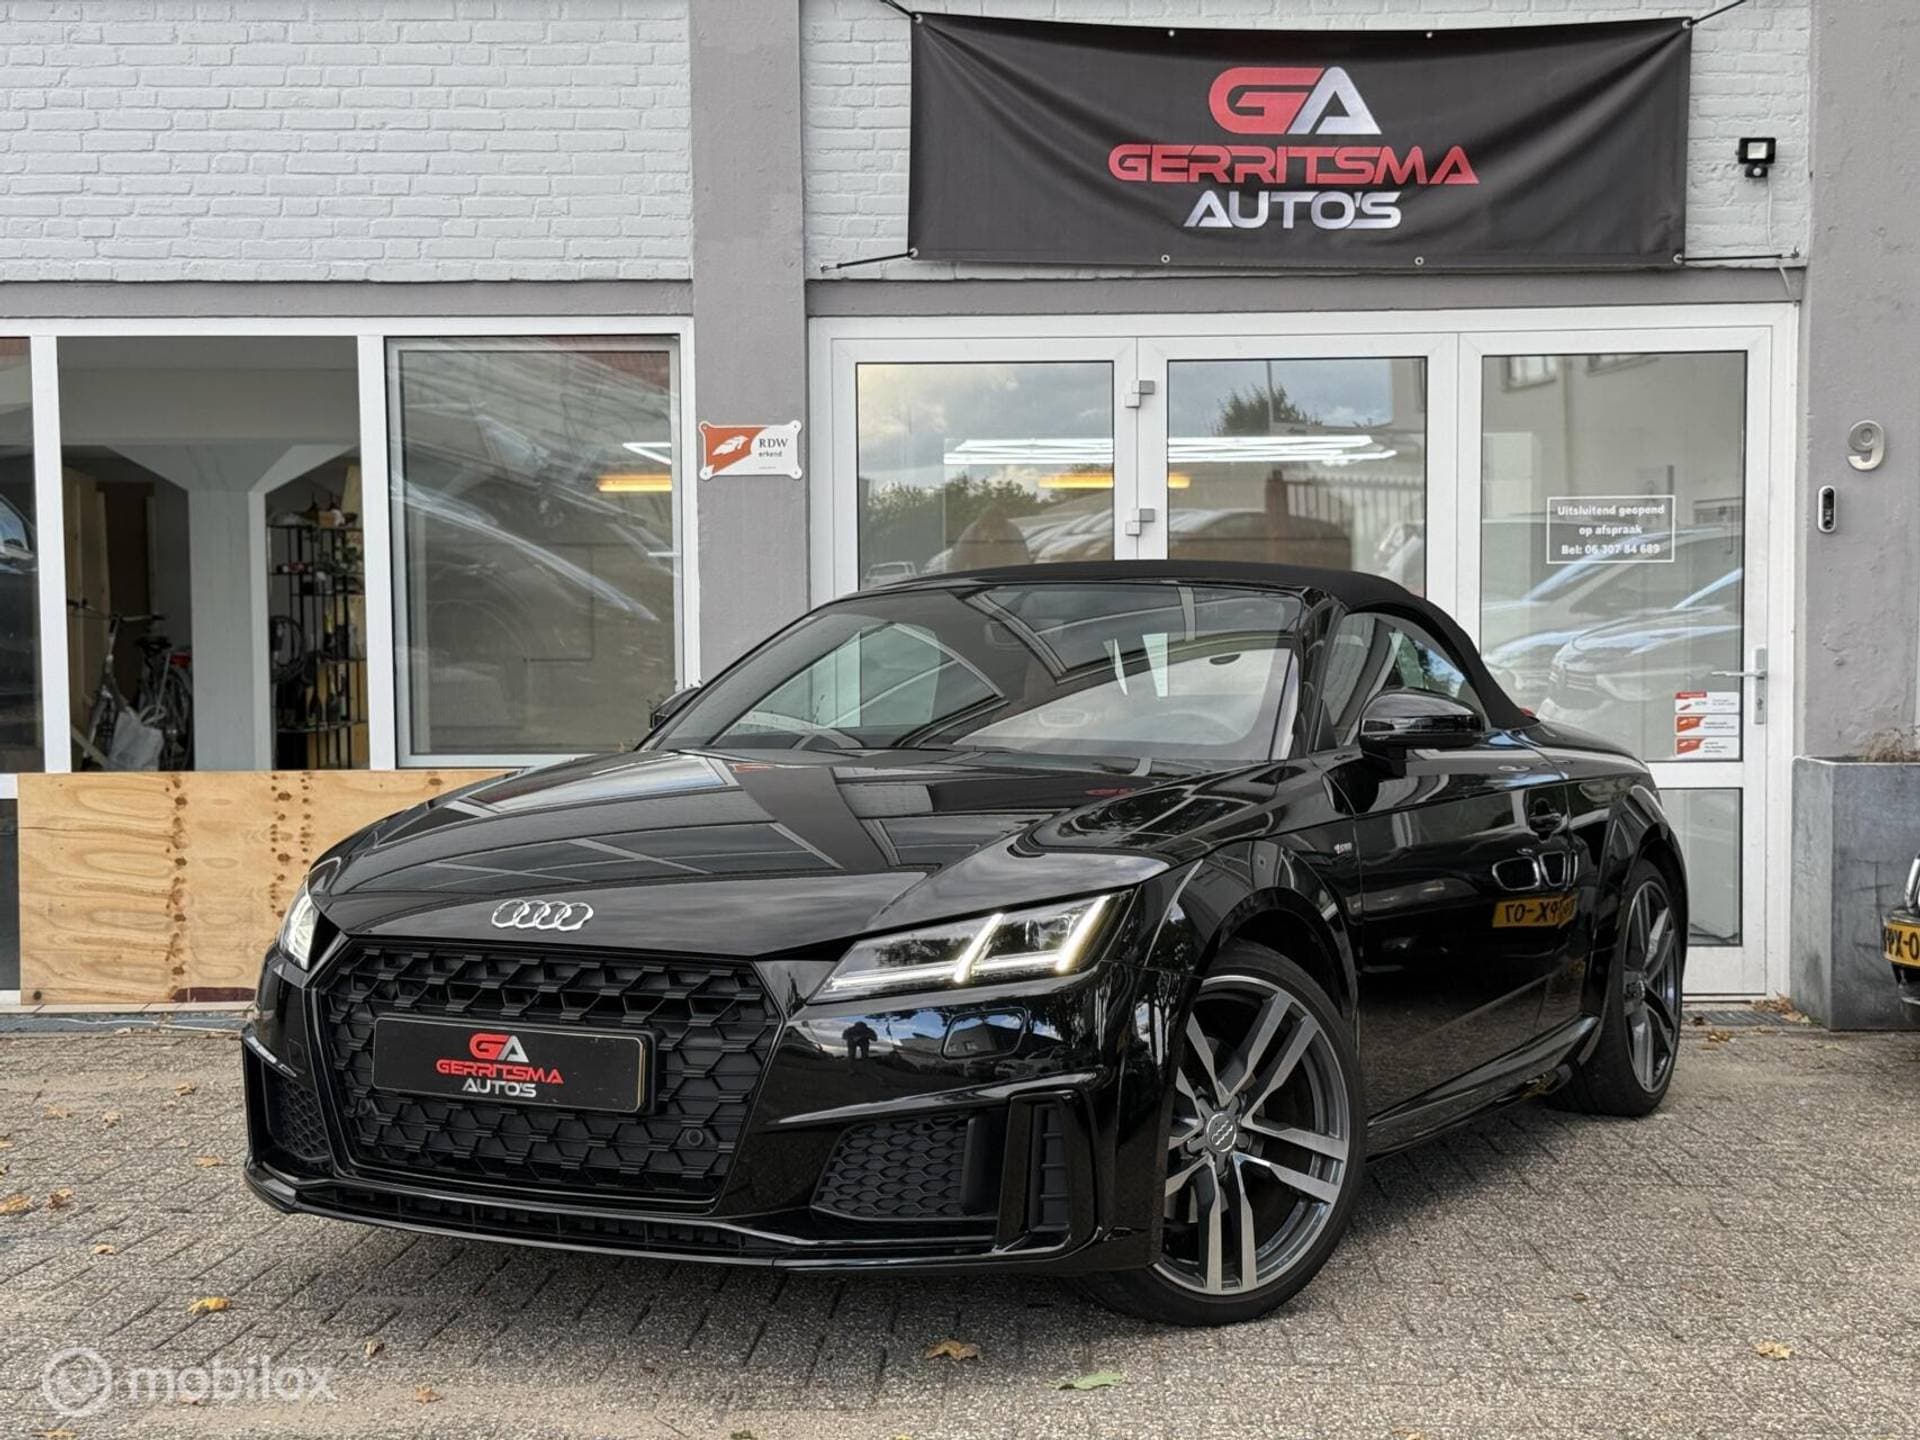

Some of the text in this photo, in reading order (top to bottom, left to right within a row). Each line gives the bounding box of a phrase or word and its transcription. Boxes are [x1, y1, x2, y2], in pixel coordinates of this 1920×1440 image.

[1208, 66, 1382, 135] GA
[1108, 143, 1480, 184] GERRITSMA
[1183, 190, 1401, 230] AUTO'S
[758, 438, 788, 448] RDW
[1847, 420, 1884, 471] 9
[1557, 504, 1665, 517] Uitsluitend geopend
[1579, 524, 1642, 536] op afspraak
[1561, 545, 1582, 555] Bel:
[1584, 544, 1598, 554] 06
[1600, 544, 1621, 554] 307
[469, 1033, 529, 1062] GA
[436, 1059, 564, 1084] GERRITSMA
[462, 1077, 537, 1098] AUTO'S
